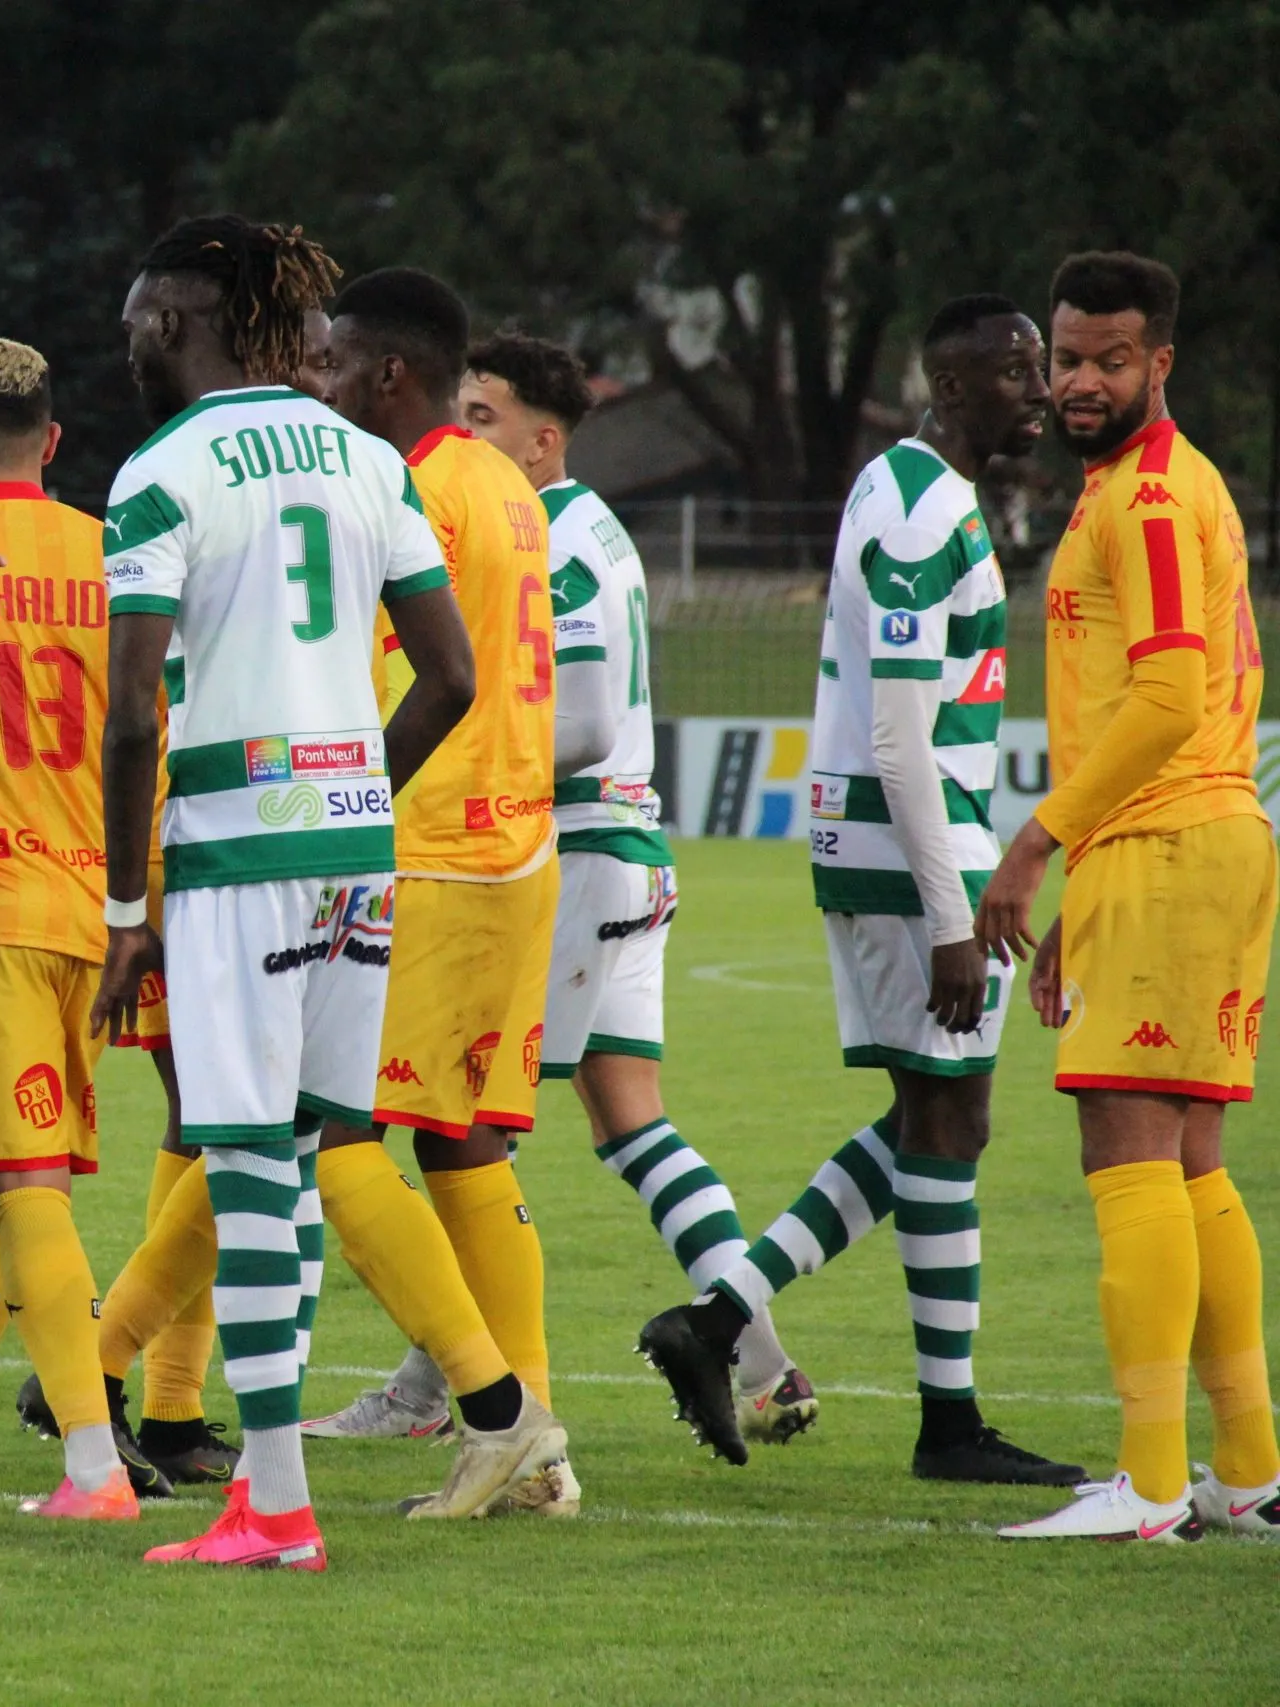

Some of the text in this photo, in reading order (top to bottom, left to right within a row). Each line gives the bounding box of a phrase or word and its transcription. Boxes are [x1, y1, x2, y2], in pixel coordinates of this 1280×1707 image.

[279, 503, 338, 644] 3
[891, 616, 911, 636] N
[516, 572, 554, 706] 5
[983, 656, 1006, 692] A
[297, 748, 326, 764] Pont
[327, 744, 360, 762] Neuf
[253, 766, 288, 777] Five Star
[519, 1206, 529, 1220] 5
